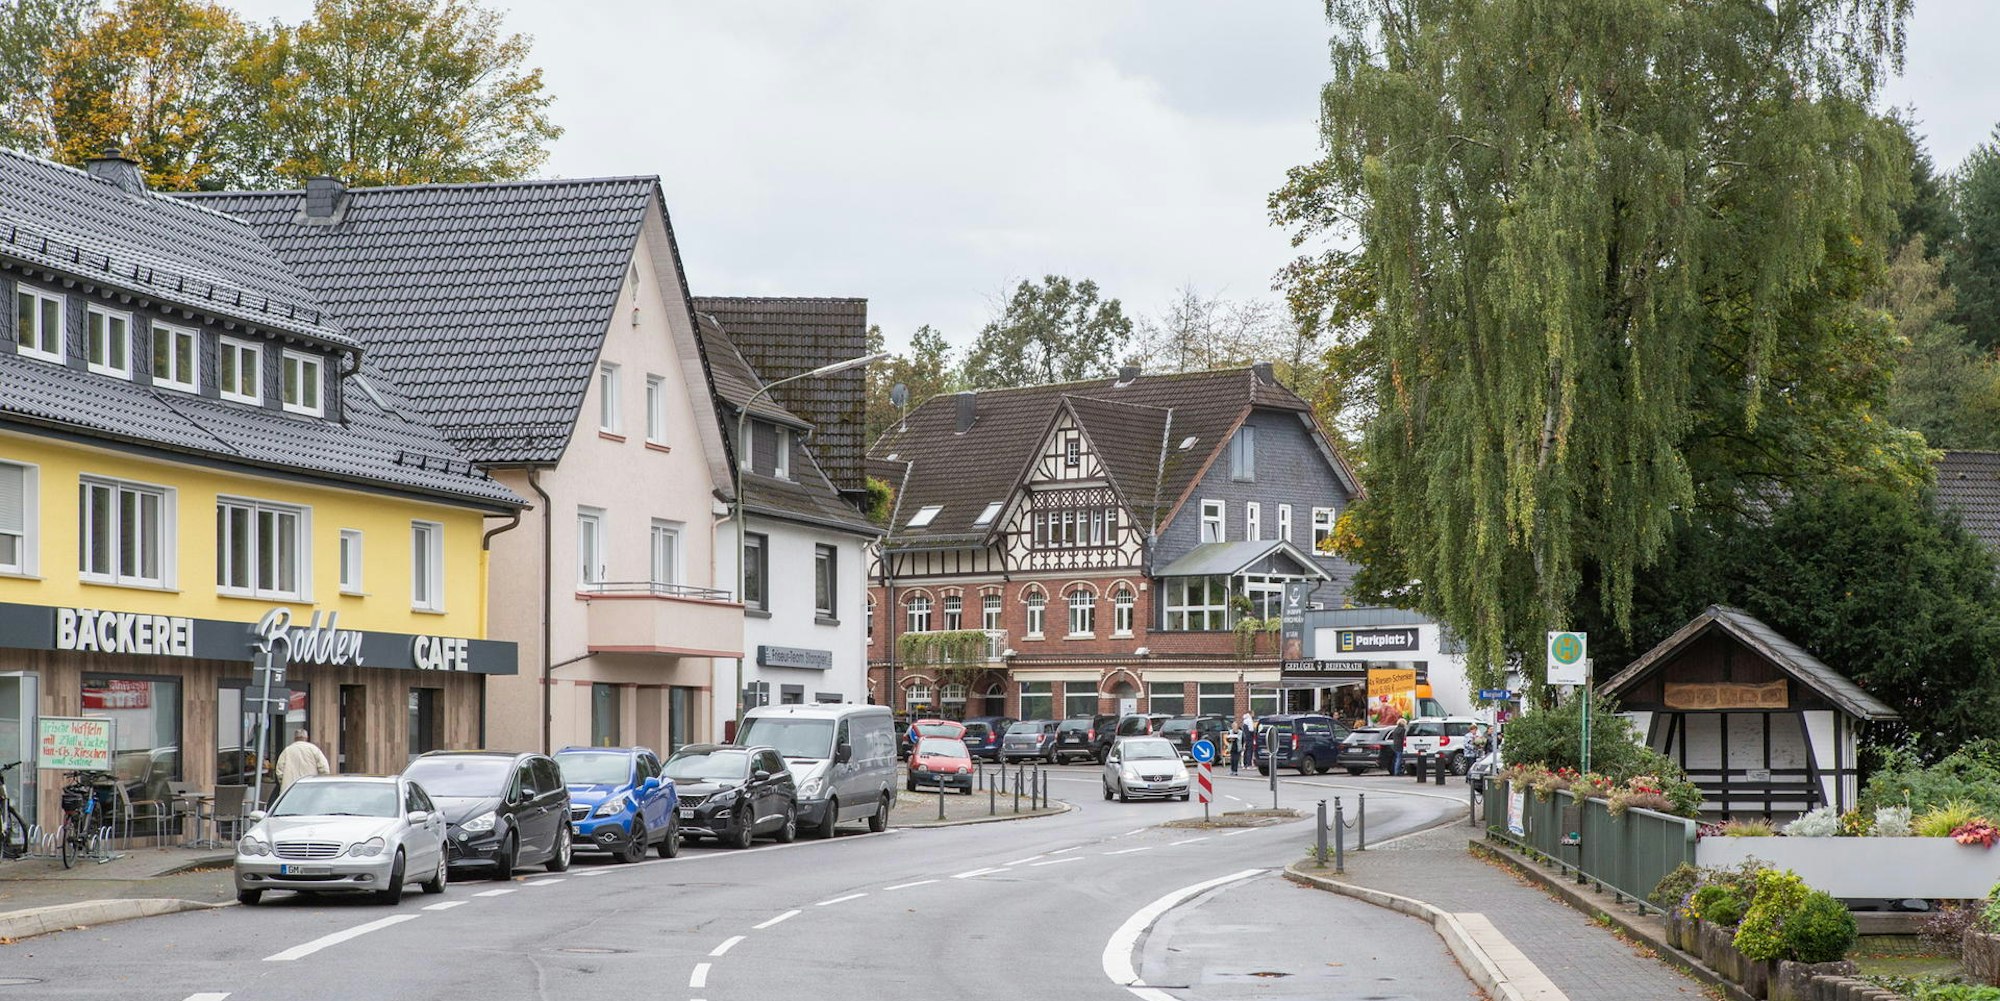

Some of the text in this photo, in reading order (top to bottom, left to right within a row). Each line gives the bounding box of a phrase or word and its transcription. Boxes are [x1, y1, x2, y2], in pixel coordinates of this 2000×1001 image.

[57, 607, 194, 657] BÄCKEREI
[250, 607, 364, 666] Bodden
[1355, 634, 1406, 647] Parkplatz
